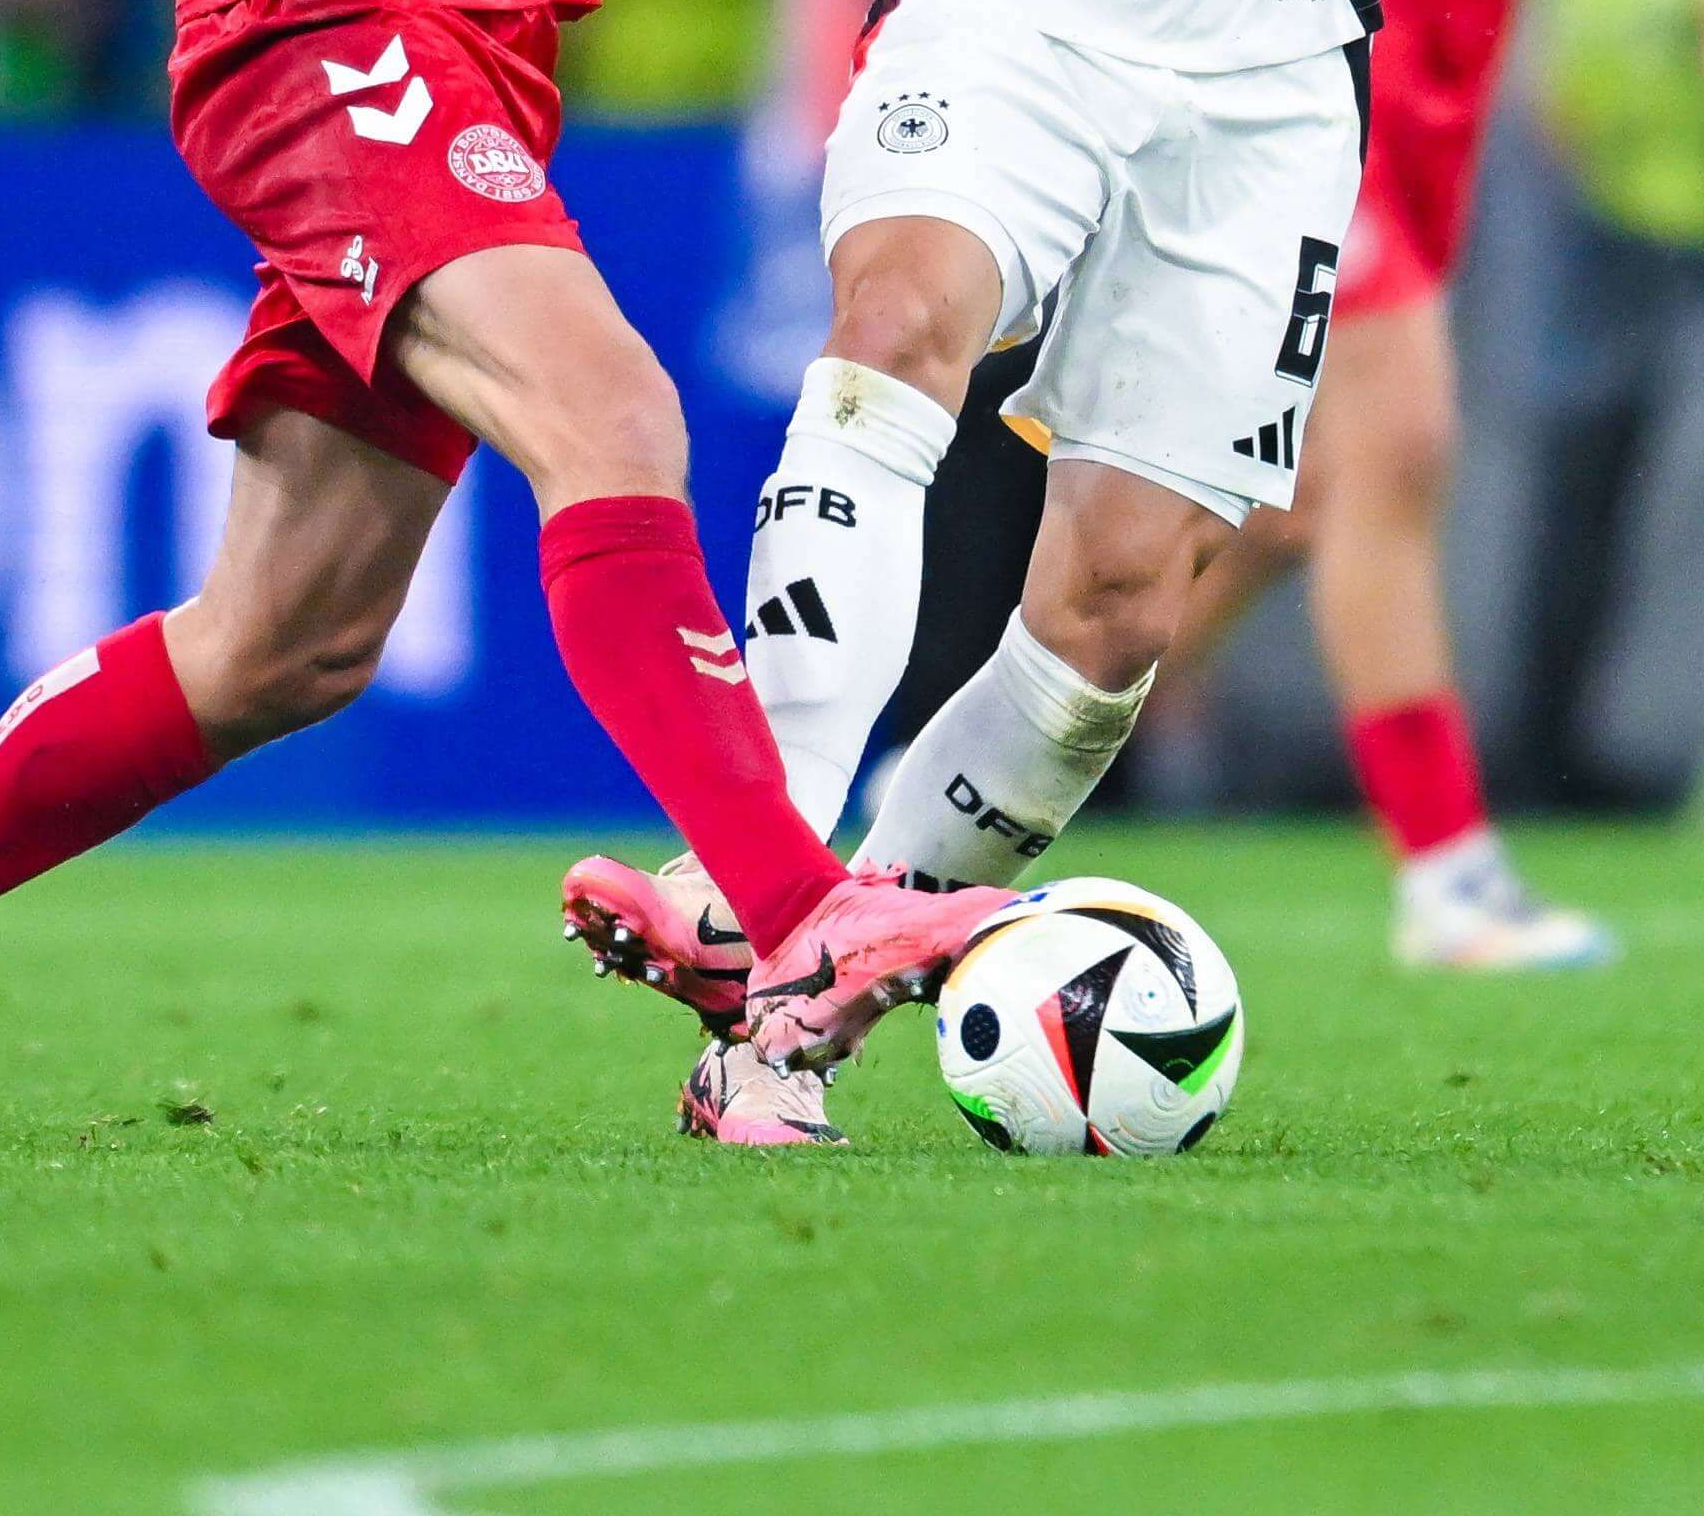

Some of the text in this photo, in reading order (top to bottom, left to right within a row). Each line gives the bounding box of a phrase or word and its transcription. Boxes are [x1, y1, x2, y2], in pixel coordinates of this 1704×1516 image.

[468, 148, 530, 174] DBU
[1275, 236, 1339, 388] 6
[944, 772, 1055, 859] DFB
